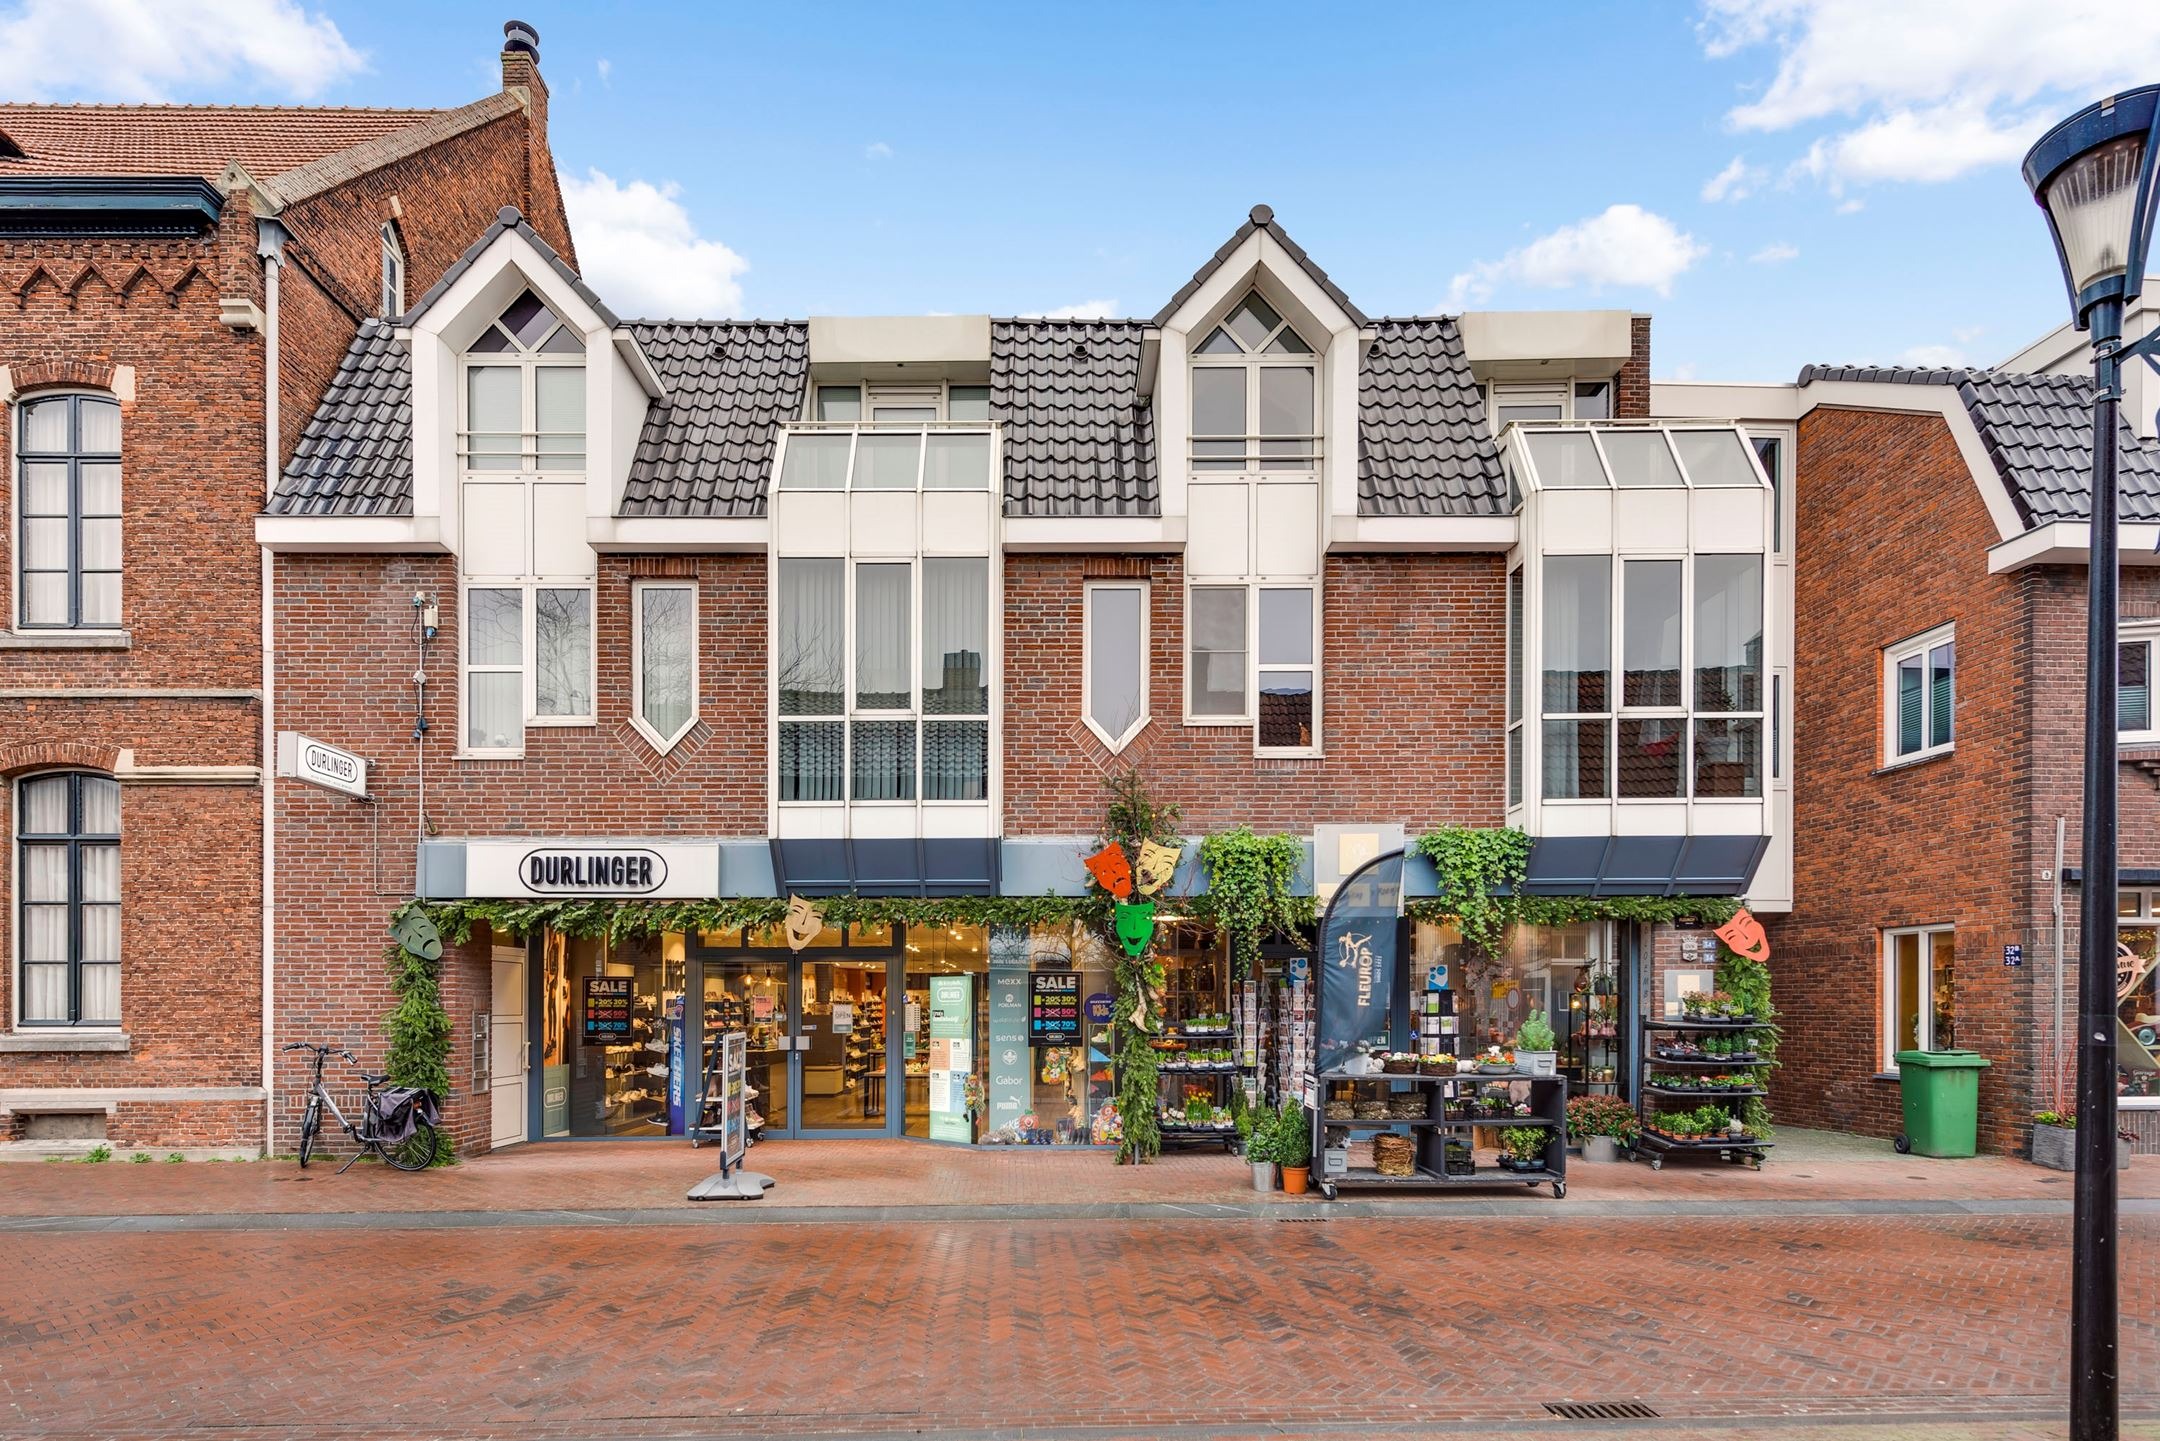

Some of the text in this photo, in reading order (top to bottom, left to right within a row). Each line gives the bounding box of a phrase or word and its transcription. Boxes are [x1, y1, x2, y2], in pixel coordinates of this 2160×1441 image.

[311, 750, 353, 778] DURLINGER
[530, 856, 653, 886] DURLINGER
[1035, 976, 1076, 989] SALE
[1358, 947, 1372, 1006] FLEUROP
[590, 981, 628, 993] SALE
[673, 1026, 682, 1107] SKECHERS
[995, 1075, 1024, 1086] Gabor
[996, 1102, 1018, 1110] PUMA
